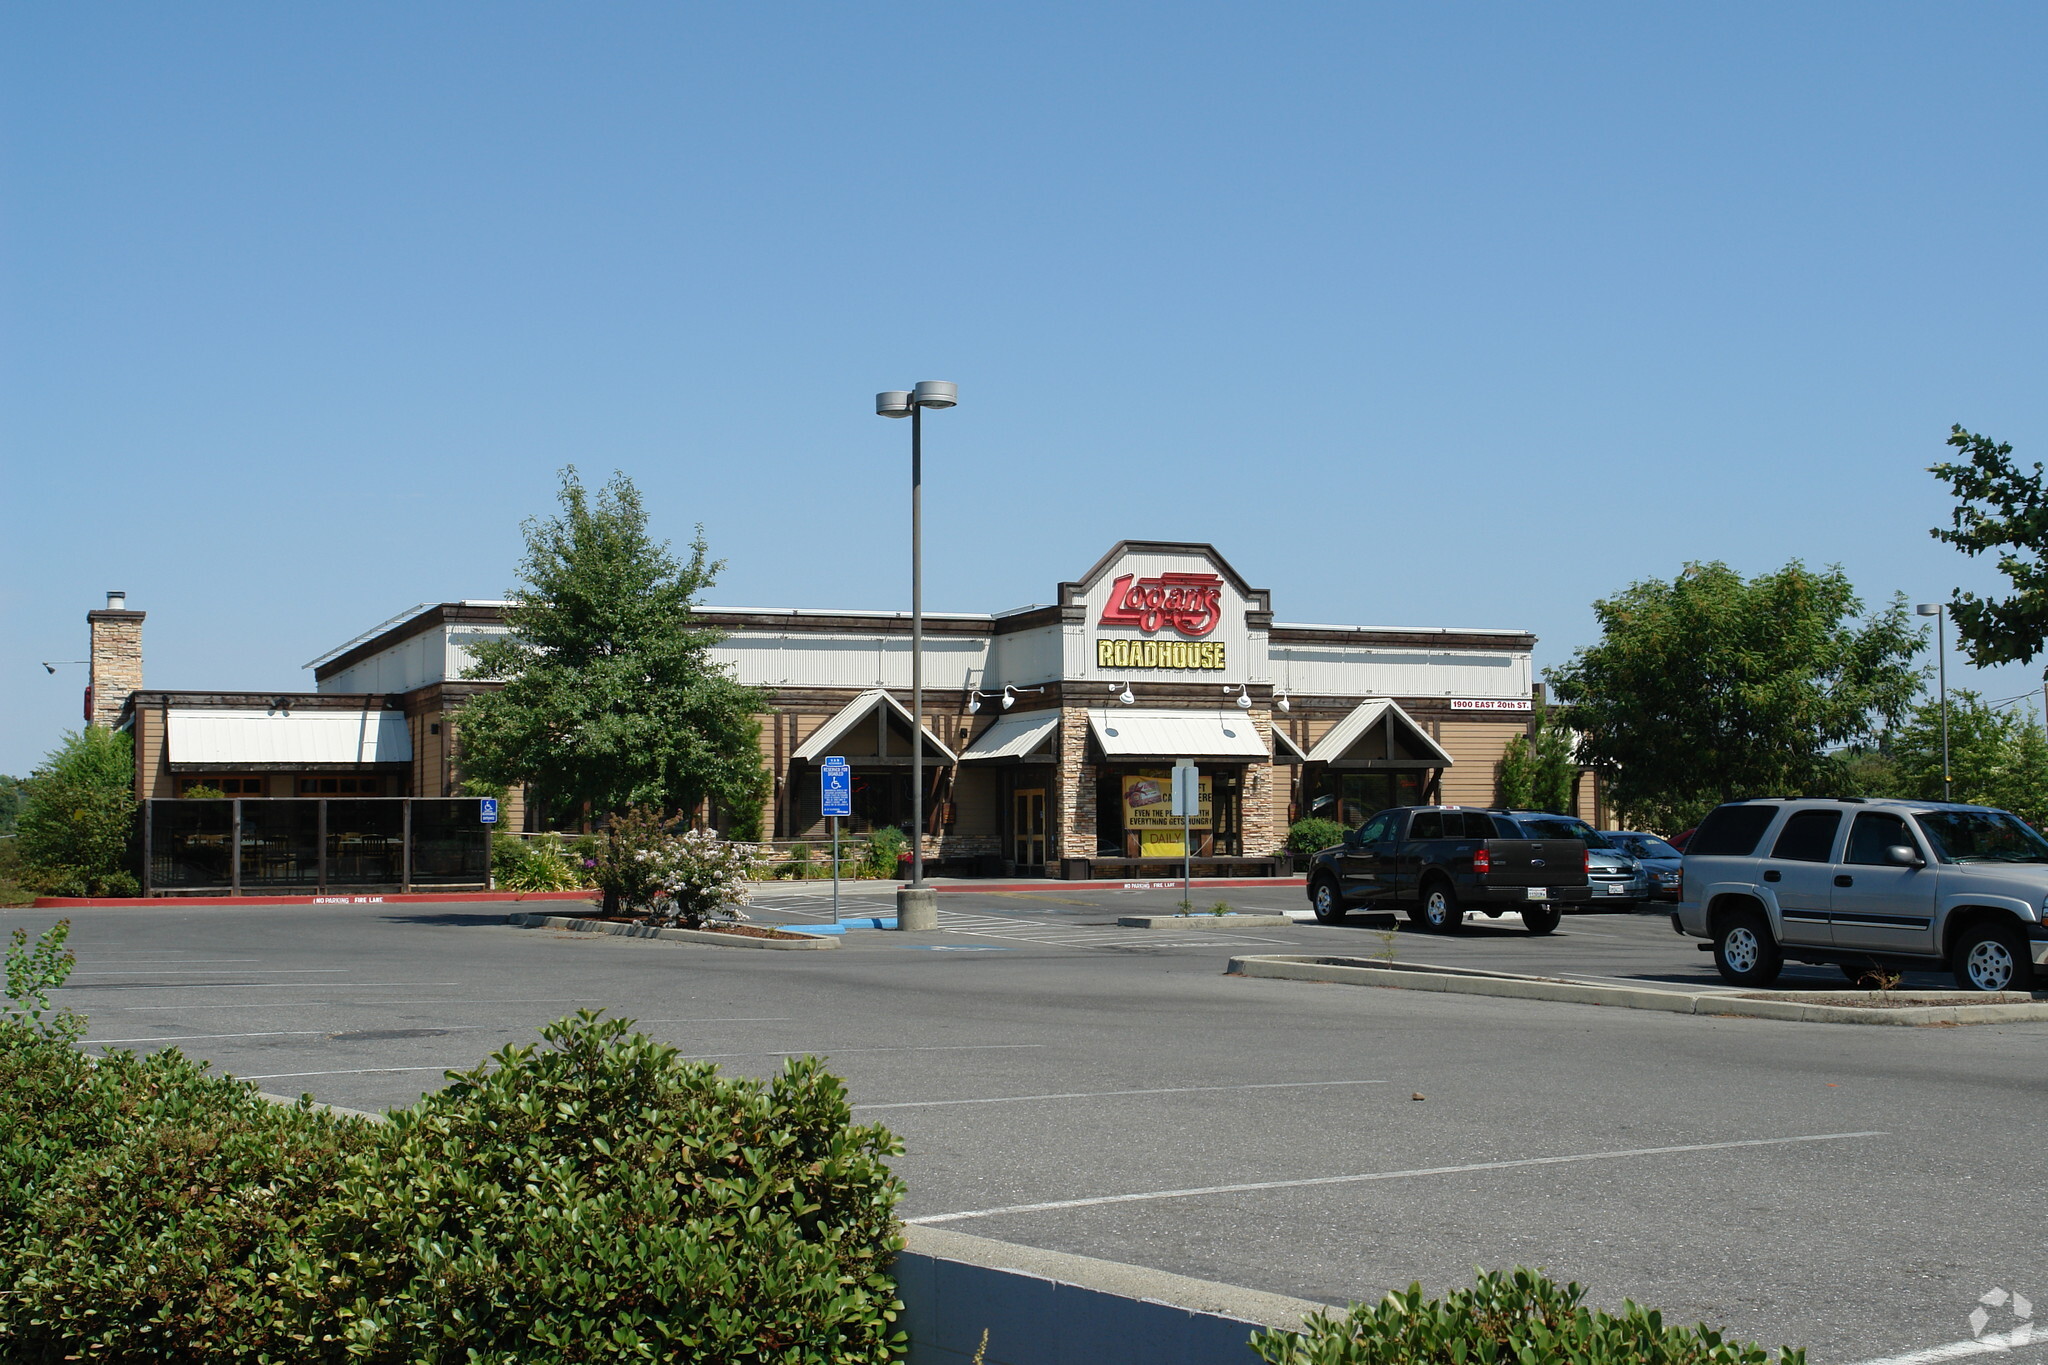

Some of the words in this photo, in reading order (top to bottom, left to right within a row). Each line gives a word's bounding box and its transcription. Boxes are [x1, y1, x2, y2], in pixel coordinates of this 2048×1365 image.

[1099, 572, 1223, 636] Logan's
[1097, 639, 1225, 670] ROADHOUSE
[1497, 701, 1515, 709] 20th
[1150, 833, 1181, 844] DAILY
